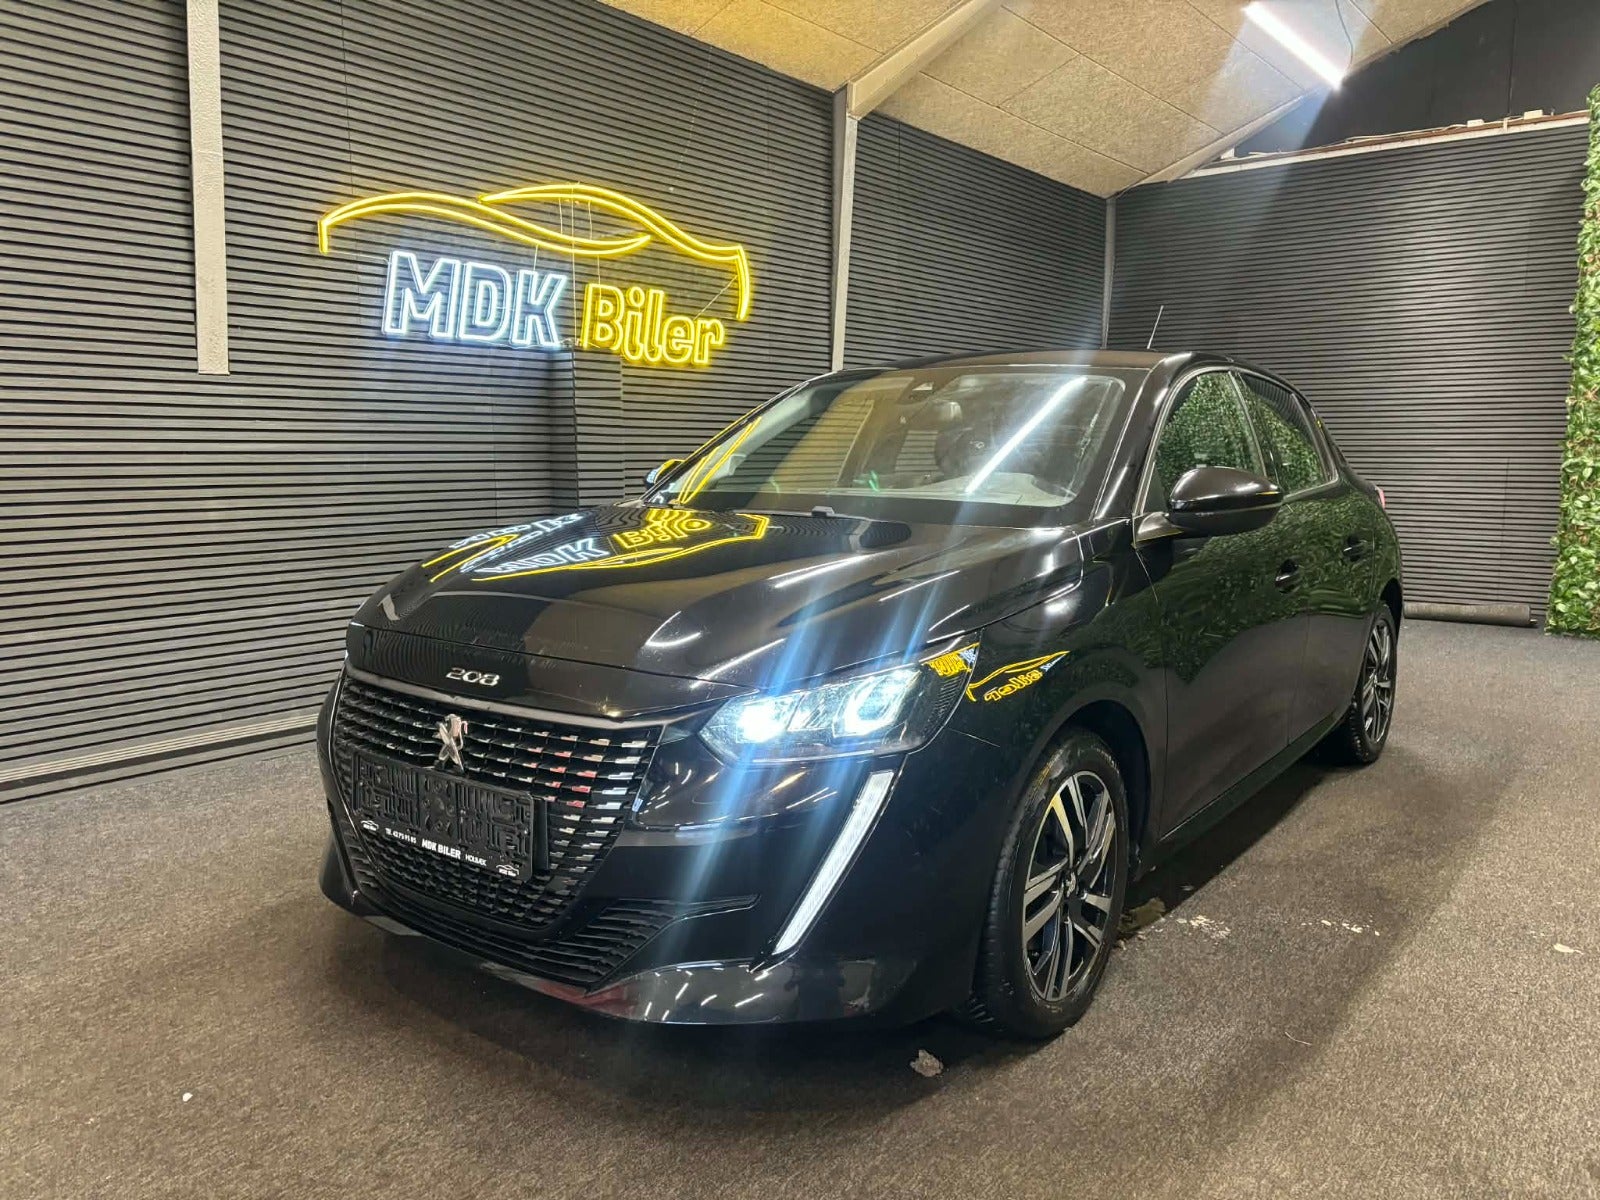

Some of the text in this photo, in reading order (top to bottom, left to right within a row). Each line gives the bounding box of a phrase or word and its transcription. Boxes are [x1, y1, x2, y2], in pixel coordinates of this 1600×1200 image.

[381, 249, 725, 366] MDK Biler
[446, 667, 500, 687] 208
[421, 838, 437, 852] MDK
[437, 843, 461, 860] BILER
